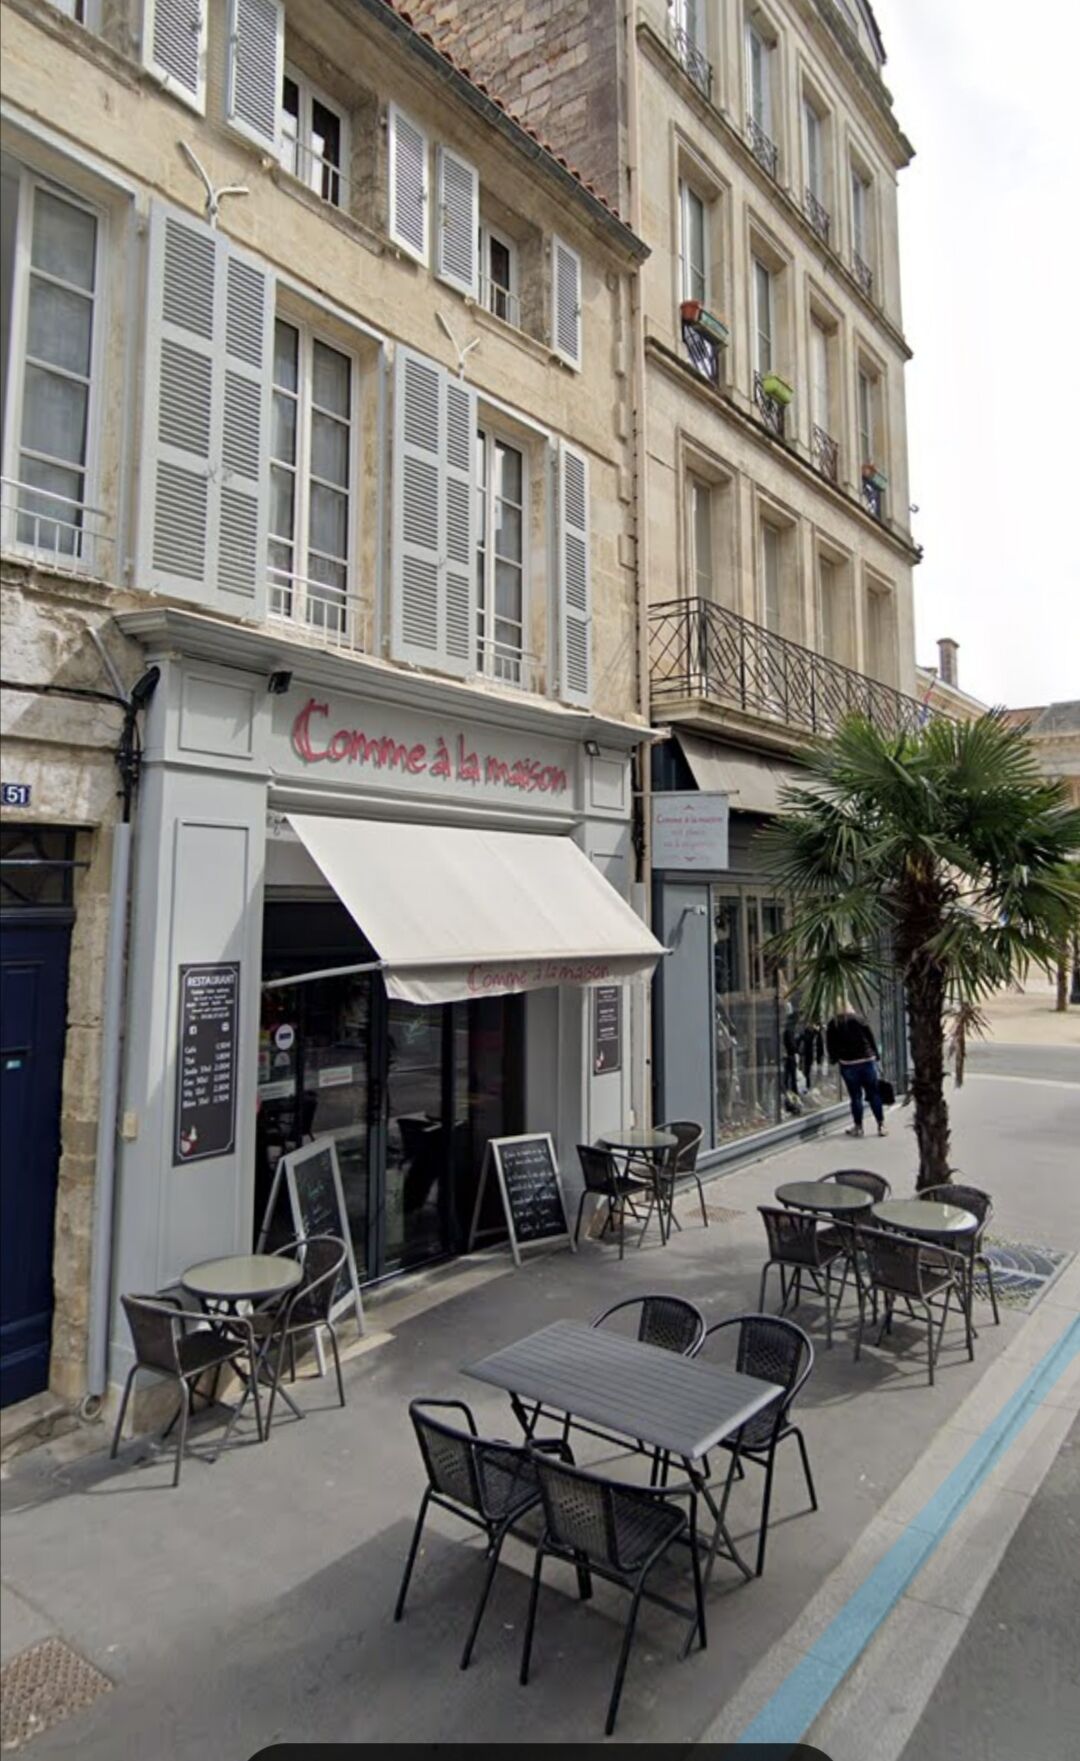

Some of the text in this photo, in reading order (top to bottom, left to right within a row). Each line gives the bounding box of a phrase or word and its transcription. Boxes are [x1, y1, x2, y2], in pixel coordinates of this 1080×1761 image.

[291, 698, 567, 793] Comme à la maison
[7, 786, 25, 803] 51
[187, 974, 234, 986] RESTAURANT
[466, 963, 528, 993] Comme
[556, 963, 610, 982] maison
